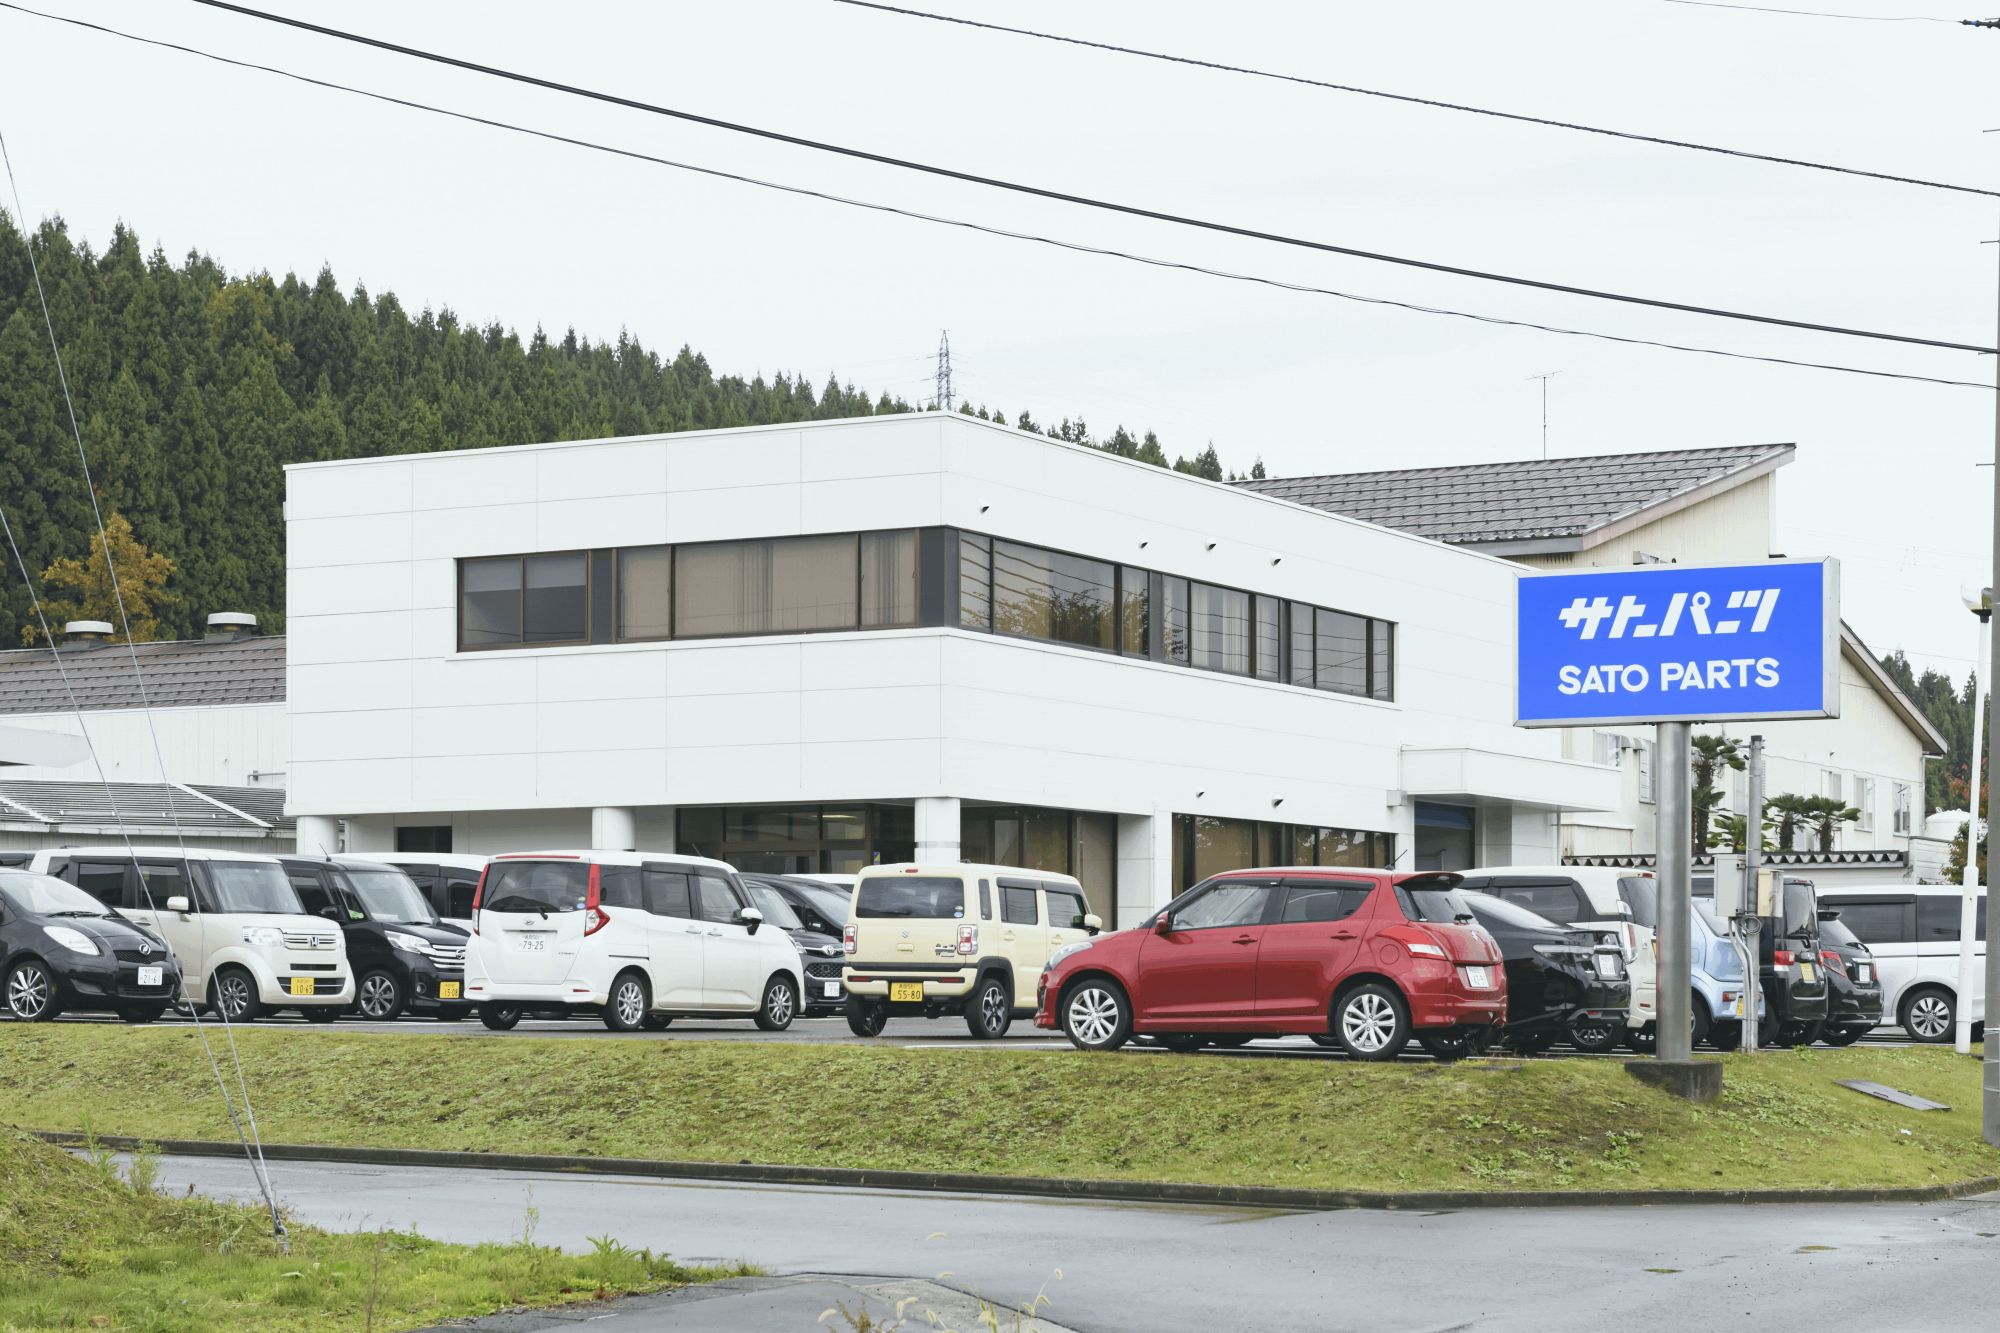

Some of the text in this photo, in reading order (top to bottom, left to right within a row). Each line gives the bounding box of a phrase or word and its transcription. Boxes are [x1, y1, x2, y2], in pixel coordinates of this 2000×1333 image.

[1557, 657, 1780, 695] SATO PARTS
[522, 940, 544, 950] 79-25
[897, 989, 921, 1000] 55-80
